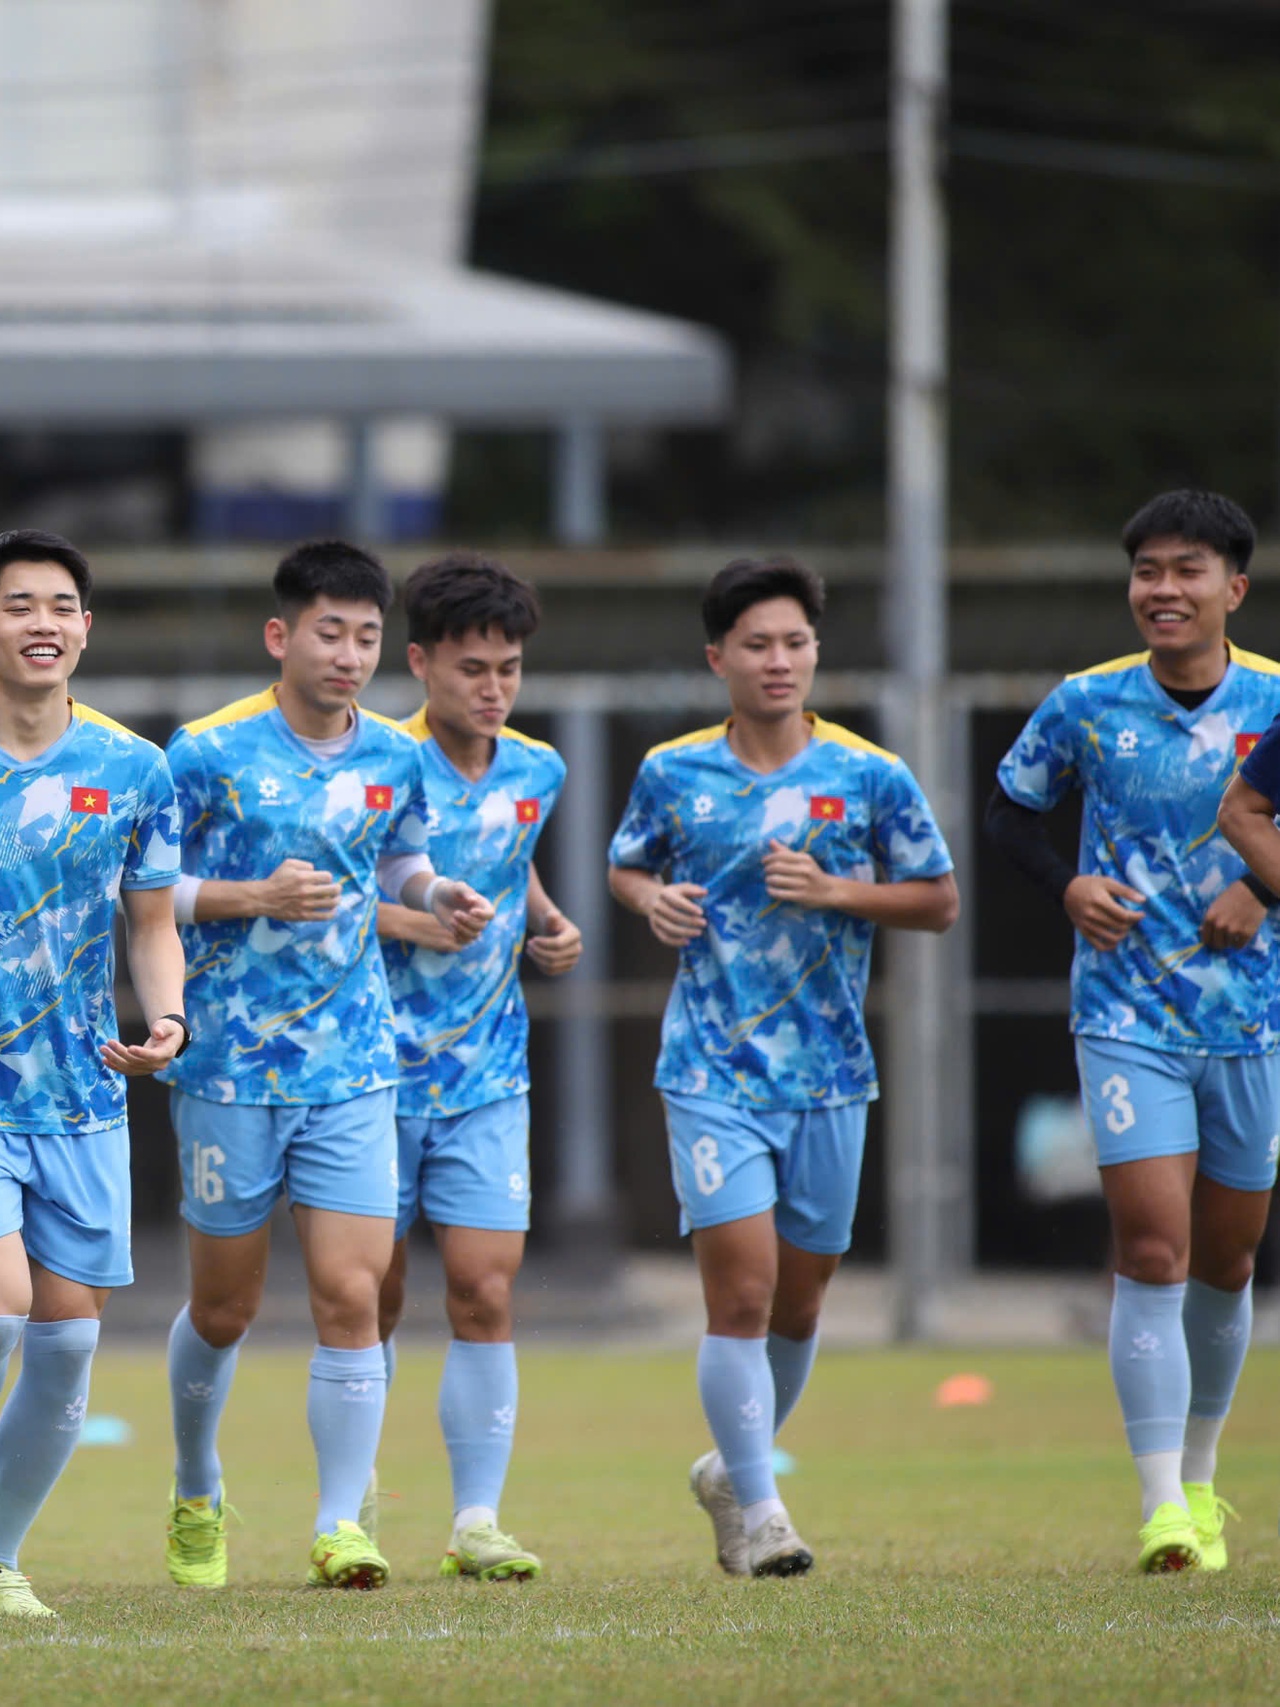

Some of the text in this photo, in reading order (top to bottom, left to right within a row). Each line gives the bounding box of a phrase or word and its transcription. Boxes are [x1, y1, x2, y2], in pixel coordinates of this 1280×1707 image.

[1101, 1073, 1136, 1135] 3
[193, 1141, 226, 1205] 16
[691, 1134, 724, 1196] 8
